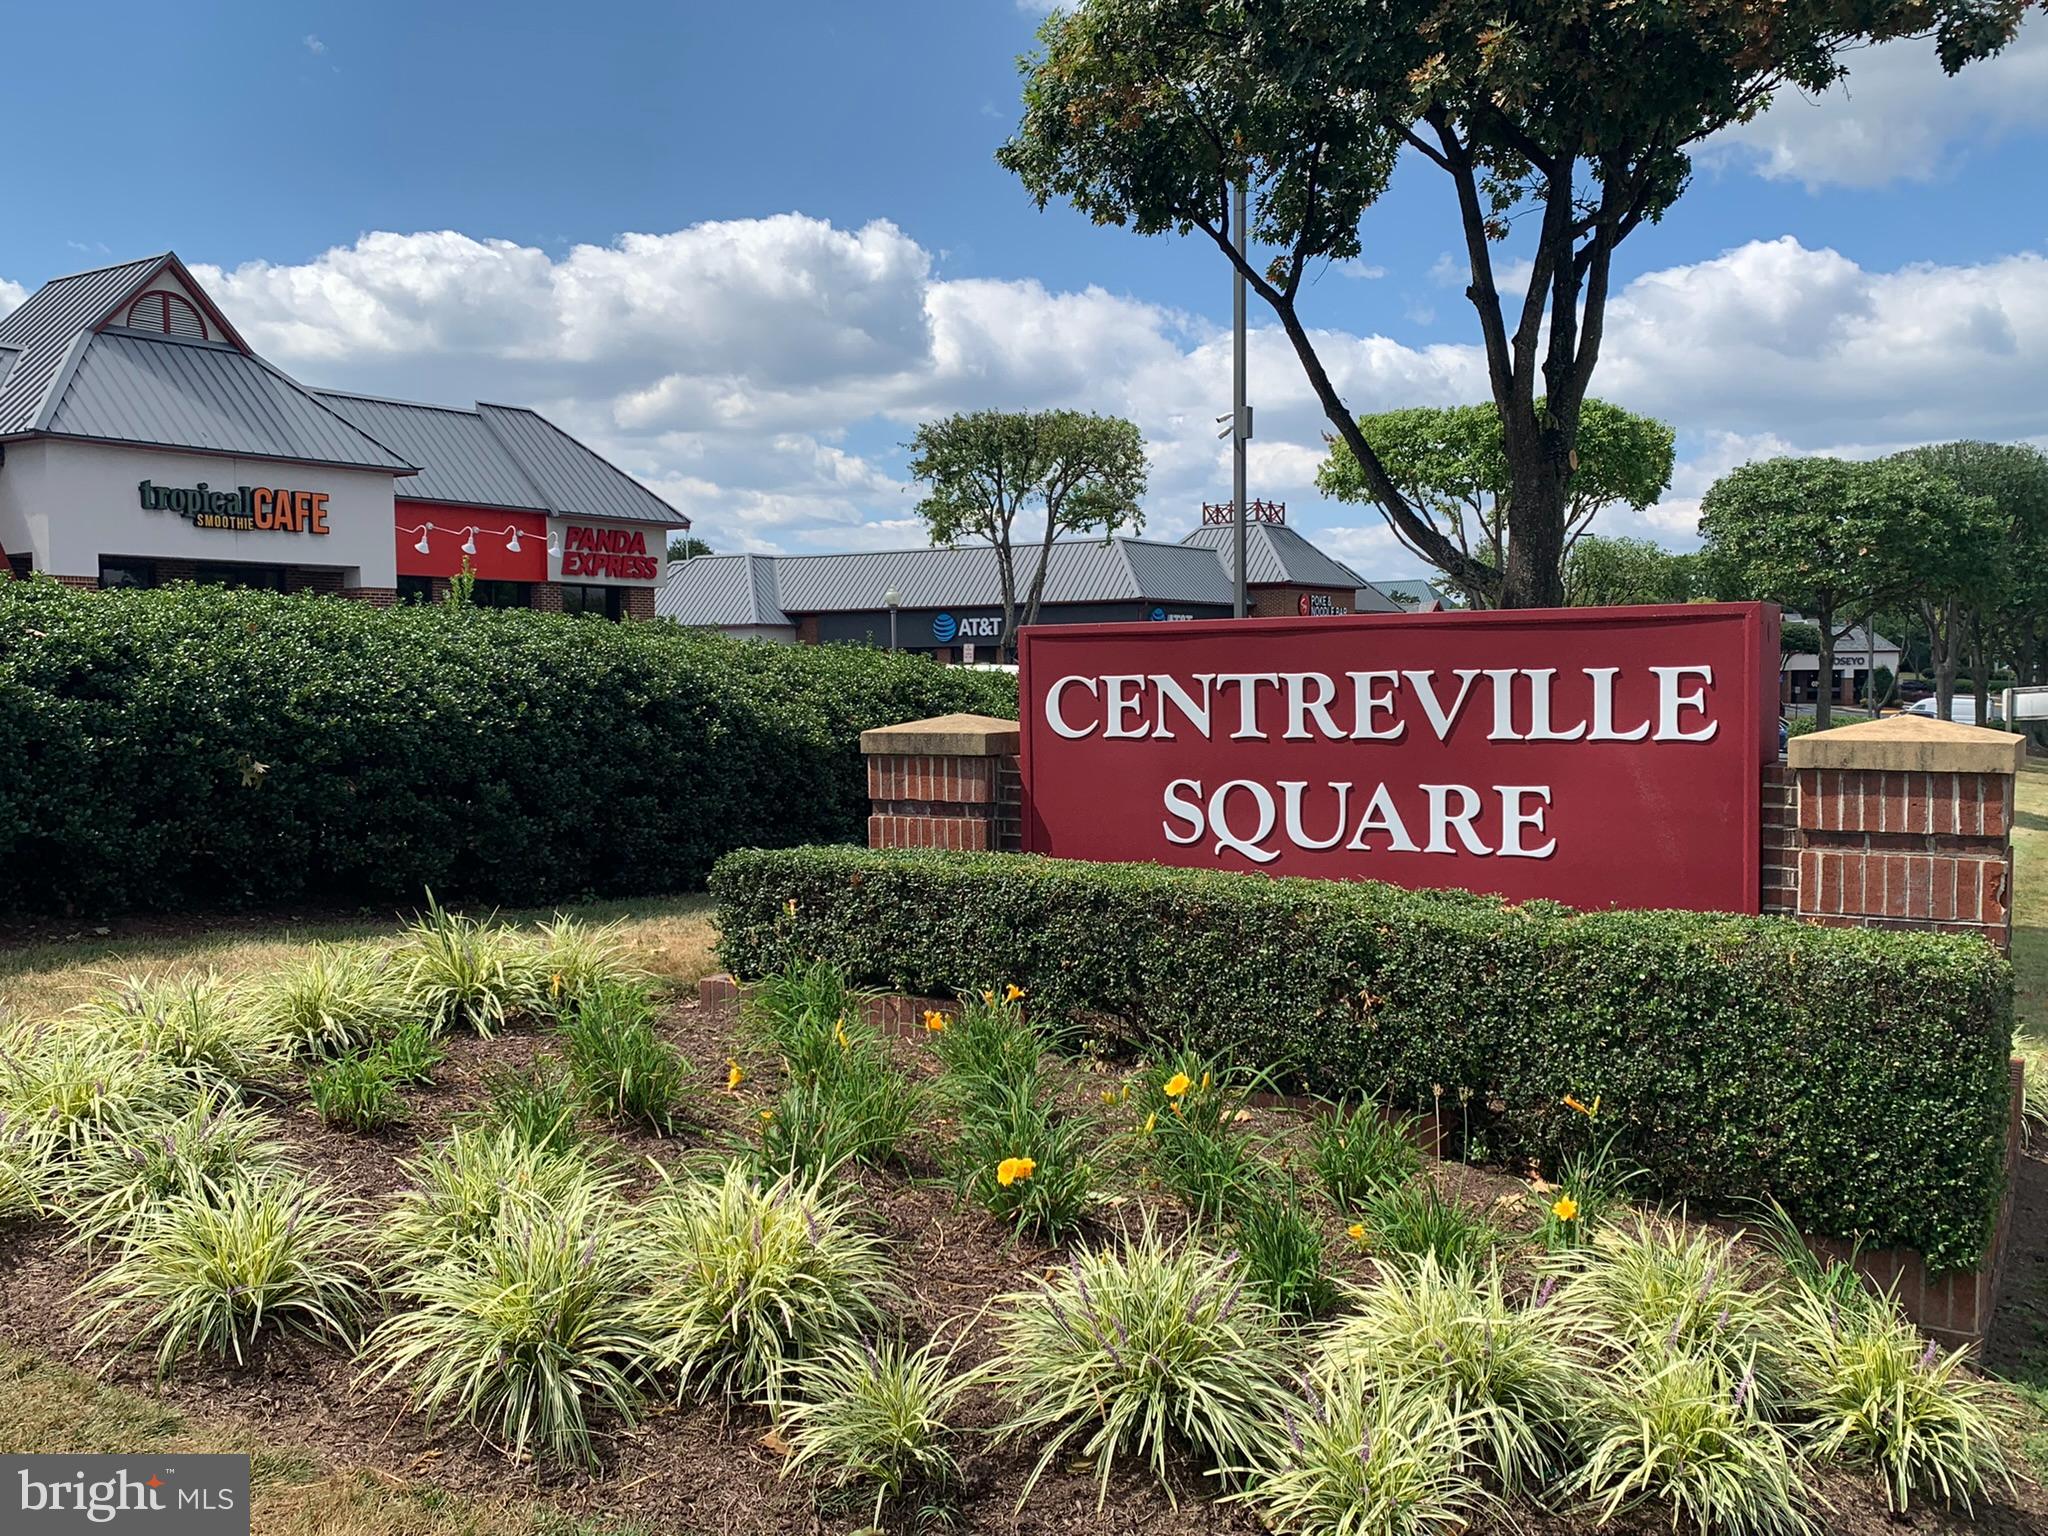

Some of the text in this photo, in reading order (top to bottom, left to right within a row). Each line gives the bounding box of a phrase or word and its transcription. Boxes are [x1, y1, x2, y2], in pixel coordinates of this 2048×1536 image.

[138, 479, 330, 535] tropical CAFE
[196, 512, 254, 531] SMOOTHIE
[564, 526, 647, 555] PANDA
[561, 551, 658, 580] EXPRESS
[1311, 595, 1327, 606] POKE
[958, 617, 1002, 636] AT&T
[1045, 665, 1719, 742] CENTREVILLE
[1162, 779, 1557, 863] SQUARE
